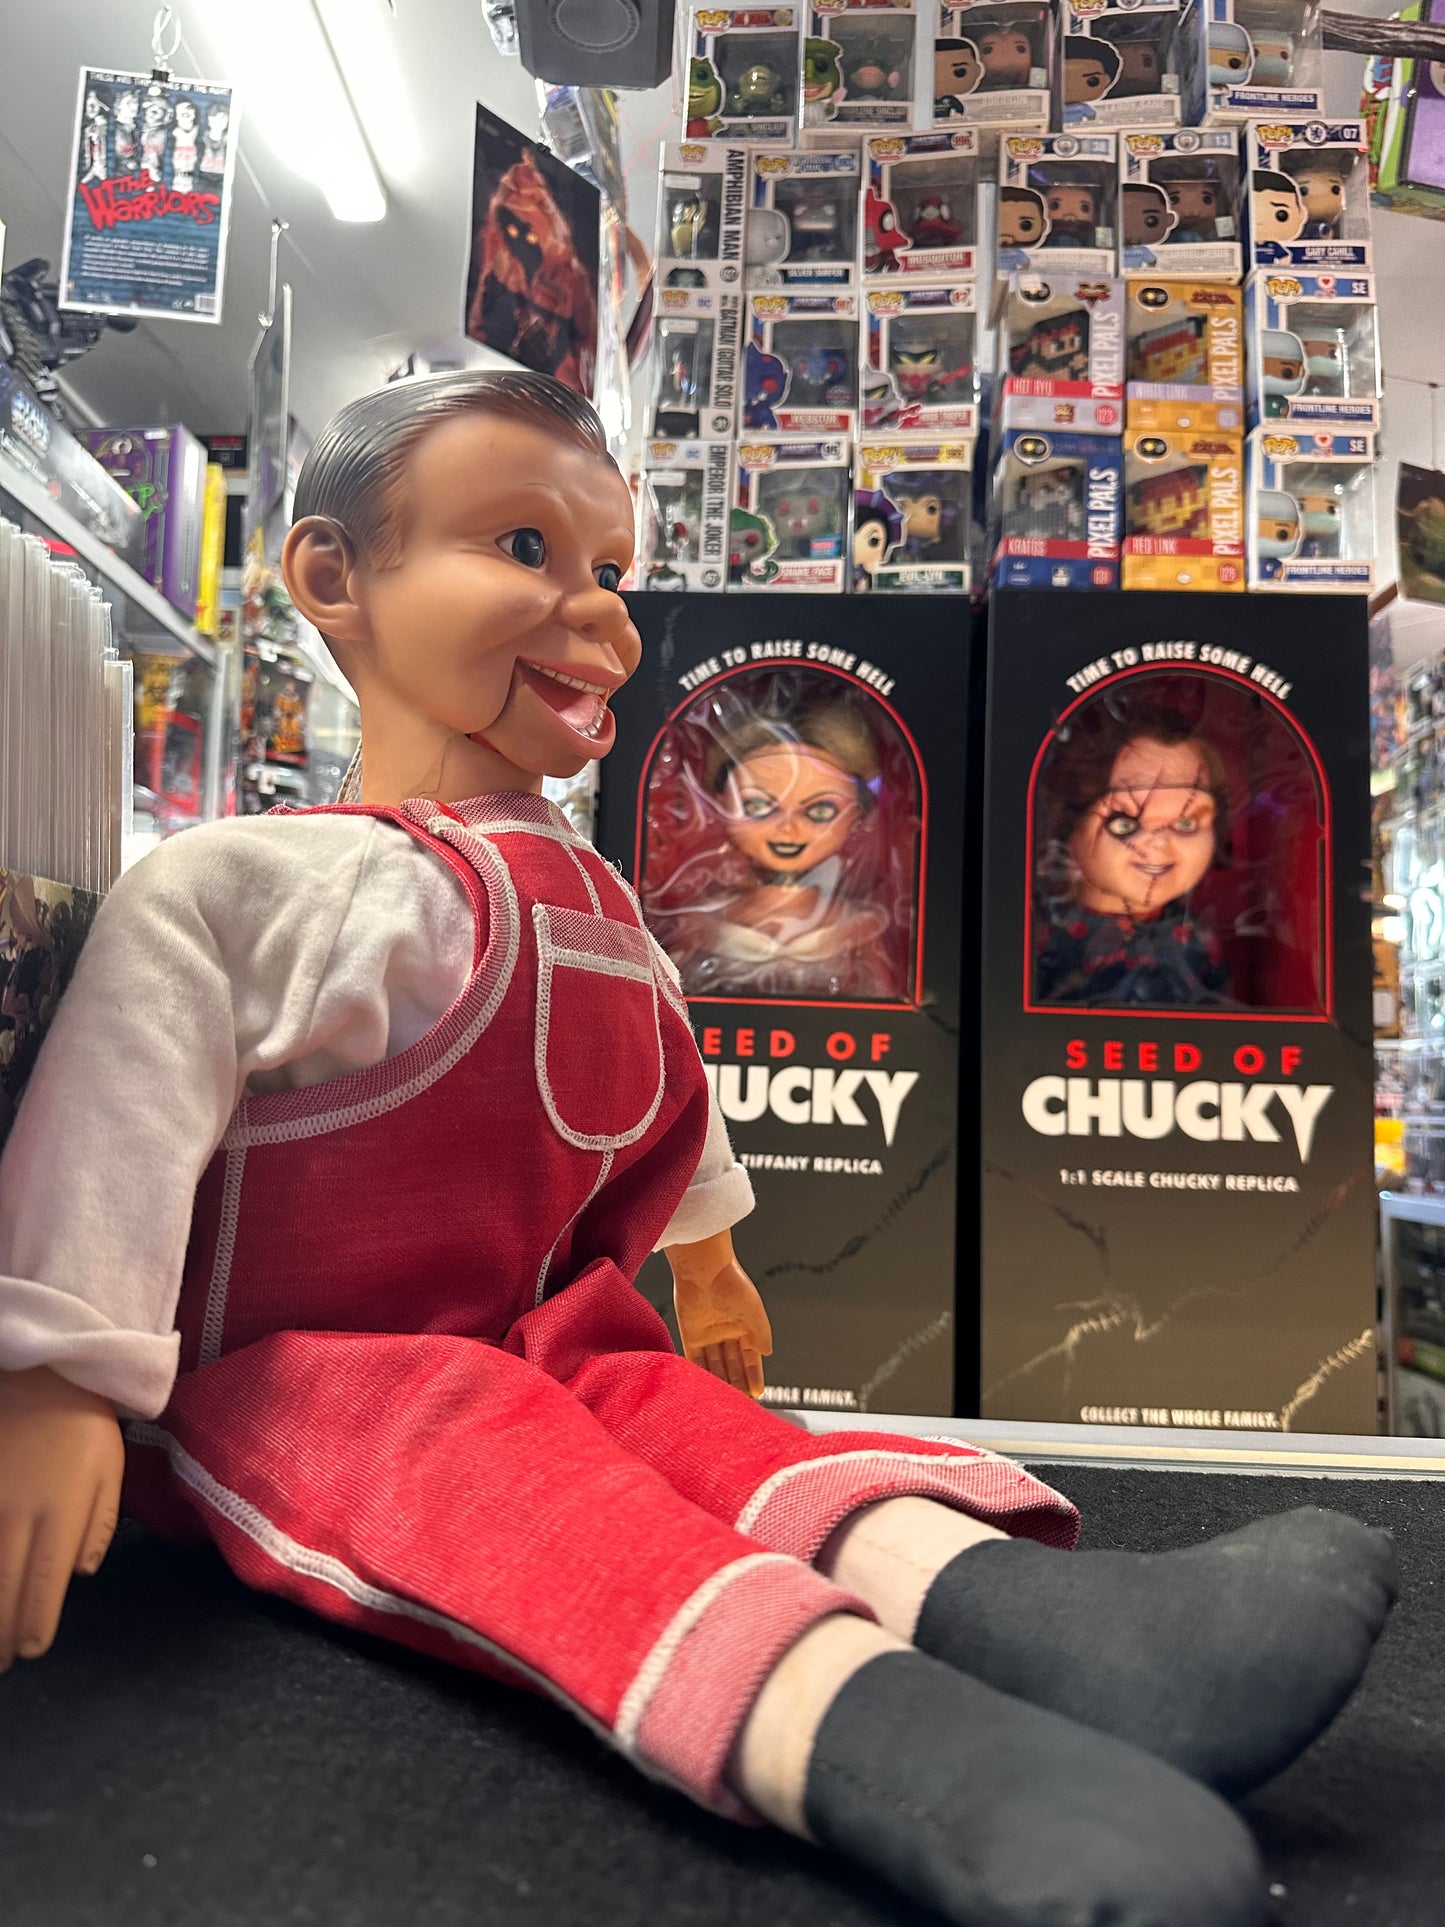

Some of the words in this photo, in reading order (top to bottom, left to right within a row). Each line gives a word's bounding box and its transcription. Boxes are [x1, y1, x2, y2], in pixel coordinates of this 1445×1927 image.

[1234, 91, 1279, 102] FRONTLINE
[1280, 93, 1315, 103] HEROES
[1343, 128, 1358, 140] 07
[113, 169, 154, 193] THE
[725, 149, 744, 226] AMPHIBIAN
[723, 230, 741, 261] MAN
[1352, 282, 1368, 294] SE
[718, 308, 738, 346] BATMAN
[1091, 312, 1120, 350] PALS
[1211, 317, 1240, 356] PALS
[1091, 353, 1121, 398] PIXEL
[1211, 358, 1240, 401] PIXEL
[1291, 404, 1338, 414] FRONTLINE
[1350, 439, 1365, 453] SE
[708, 445, 728, 494] EMPEROR
[1211, 466, 1240, 509] PALS
[1087, 467, 1118, 511] PALS
[1087, 512, 1118, 559] PIXEL
[1212, 510, 1242, 556] PIXEL
[1286, 566, 1333, 576] FRONTLINE
[678, 656, 722, 691] TIME
[721, 646, 747, 667] TO
[751, 639, 803, 660] RAISE
[806, 641, 857, 671] SOME
[855, 659, 896, 696] HELL
[1066, 656, 1112, 693] TIME
[1111, 647, 1139, 668] TO
[1141, 640, 1197, 661] RAISE
[1199, 643, 1252, 673] SOME
[1250, 661, 1293, 700] HELL
[703, 1027, 796, 1058] EED
[826, 1031, 892, 1061] OF
[1066, 1040, 1201, 1073] SEED
[1233, 1044, 1303, 1076] OF
[703, 1063, 920, 1147] UCKY
[1021, 1074, 1335, 1164] CHUCKY
[739, 1153, 810, 1172] TIFFANY
[813, 1156, 883, 1175] REPLICA
[1059, 1168, 1086, 1185] 1:1
[1091, 1169, 1146, 1188] SCALE
[1149, 1171, 1223, 1190] CHUCKY
[1225, 1173, 1300, 1193] REPLICA
[763, 1385, 800, 1404] HOLE
[1080, 1405, 1139, 1424] COLLECT
[1141, 1407, 1169, 1425] THE
[1171, 1408, 1222, 1427] WHOLE
[1223, 1409, 1280, 1428] FAMILY.
